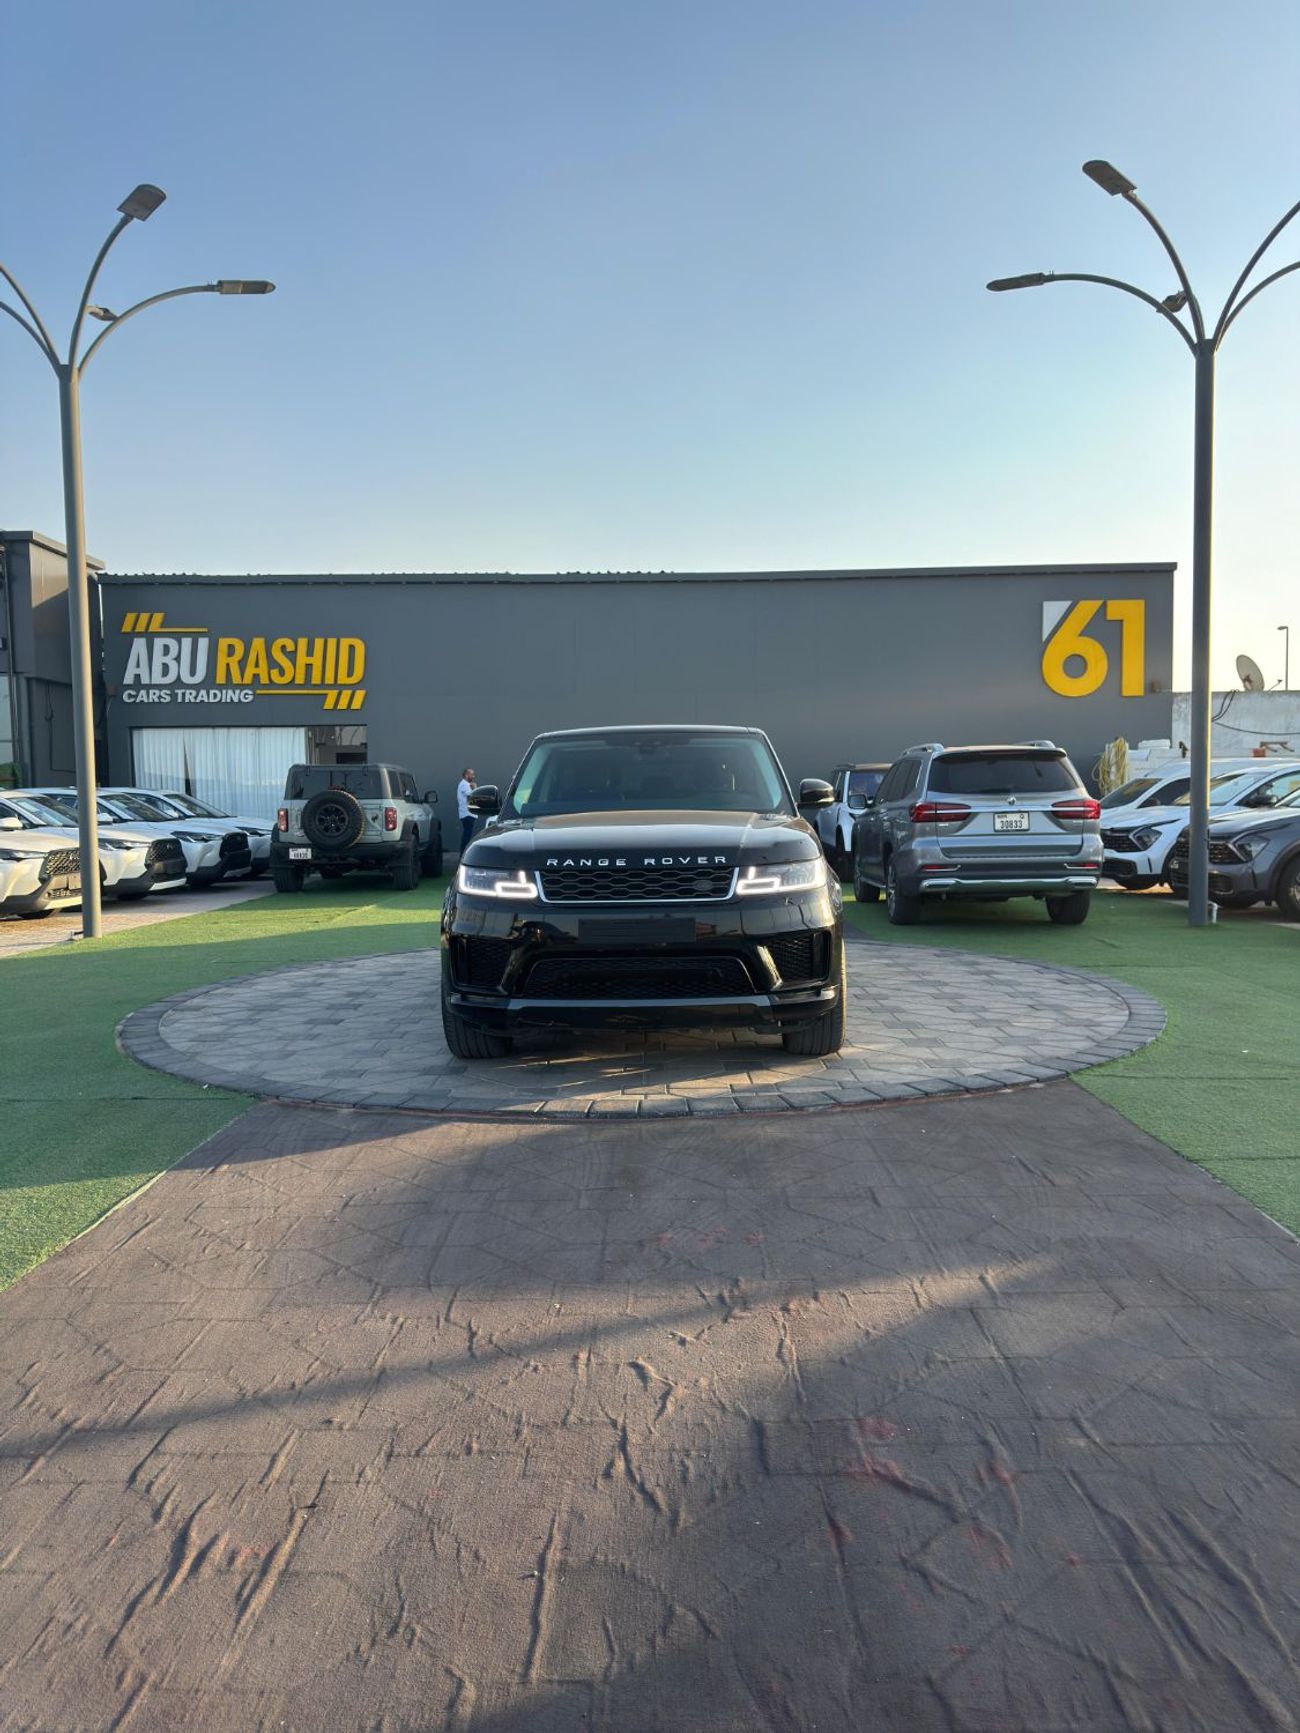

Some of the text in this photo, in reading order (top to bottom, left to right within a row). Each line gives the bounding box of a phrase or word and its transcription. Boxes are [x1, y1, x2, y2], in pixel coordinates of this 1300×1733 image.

[122, 637, 366, 685] ABU RASHID
[1041, 599, 1145, 697] 61
[122, 689, 254, 703] CARS TRADING
[546, 856, 727, 866] RANGE ROVER
